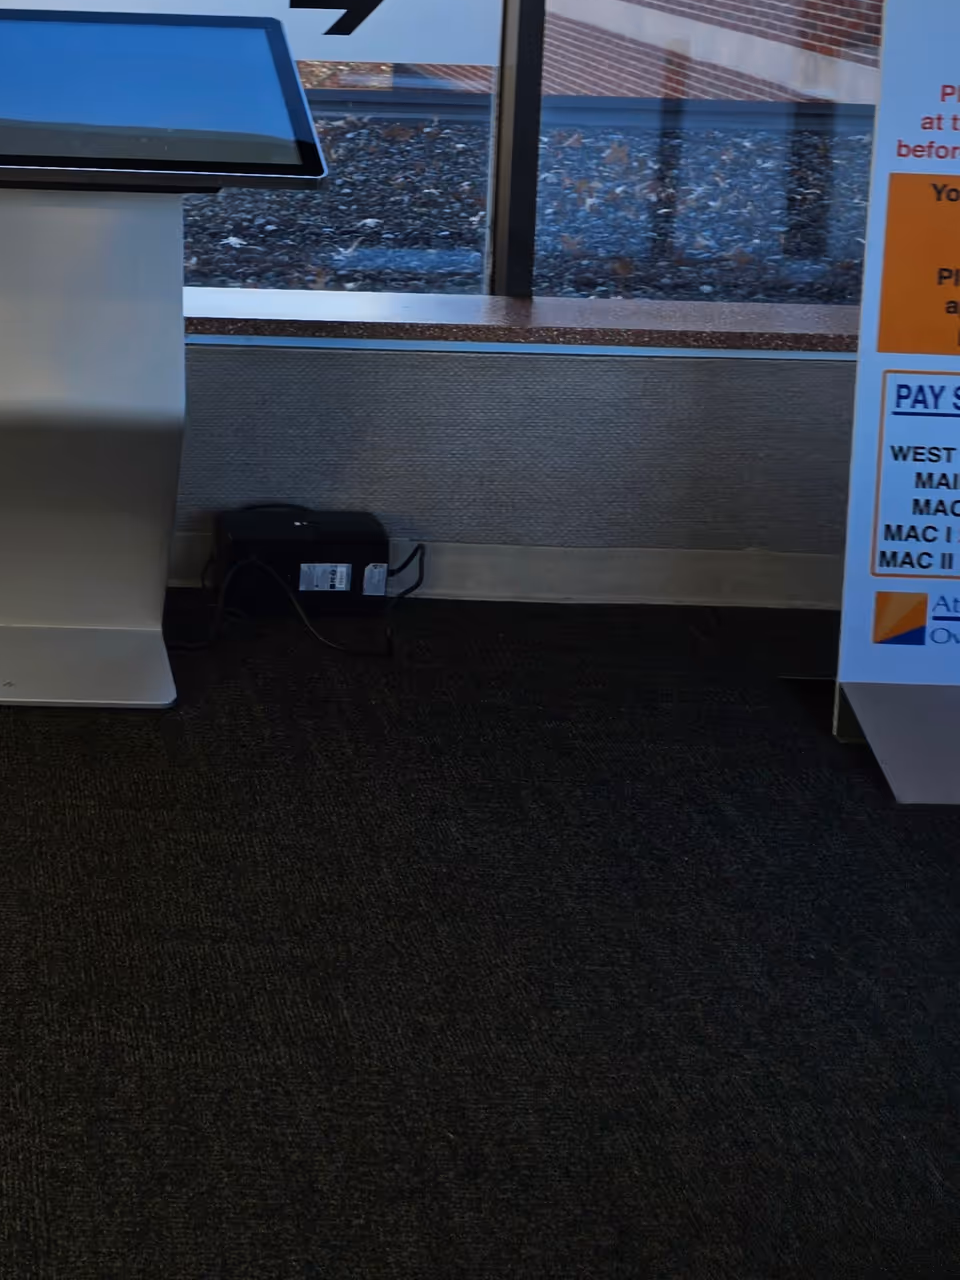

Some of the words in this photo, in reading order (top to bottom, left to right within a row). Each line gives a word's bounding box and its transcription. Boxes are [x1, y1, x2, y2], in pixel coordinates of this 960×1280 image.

[921, 114, 944, 131] at
[895, 384, 946, 410] PAY
[891, 446, 957, 463] WEST
[884, 524, 939, 543] MAC
[879, 550, 934, 569] MAC
[940, 552, 953, 570] II
